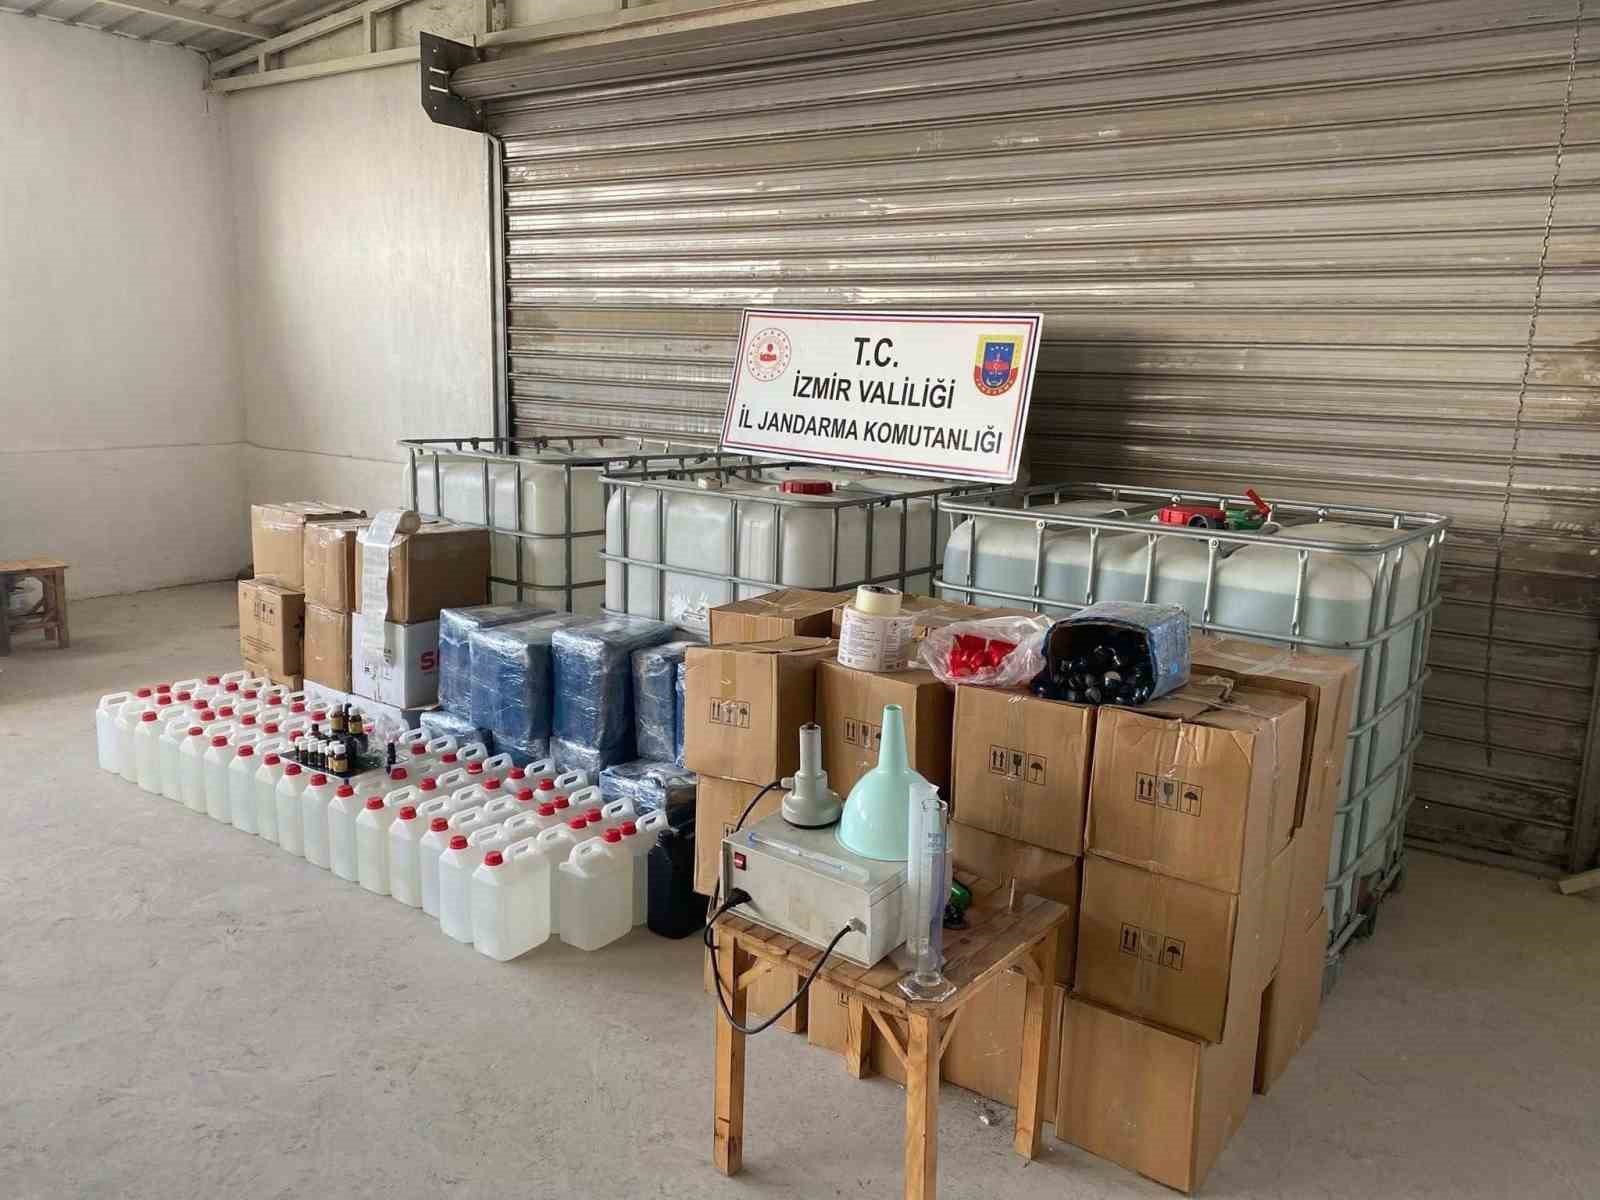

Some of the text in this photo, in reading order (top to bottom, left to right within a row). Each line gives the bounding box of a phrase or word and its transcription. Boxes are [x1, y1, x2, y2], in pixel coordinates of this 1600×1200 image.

[854, 337, 898, 367] T.C.
[793, 370, 852, 401] İZMİR
[859, 377, 956, 409] VALİLİĞİ
[739, 404, 1002, 454] İL JANDARMA KOMUTANLIĞI
